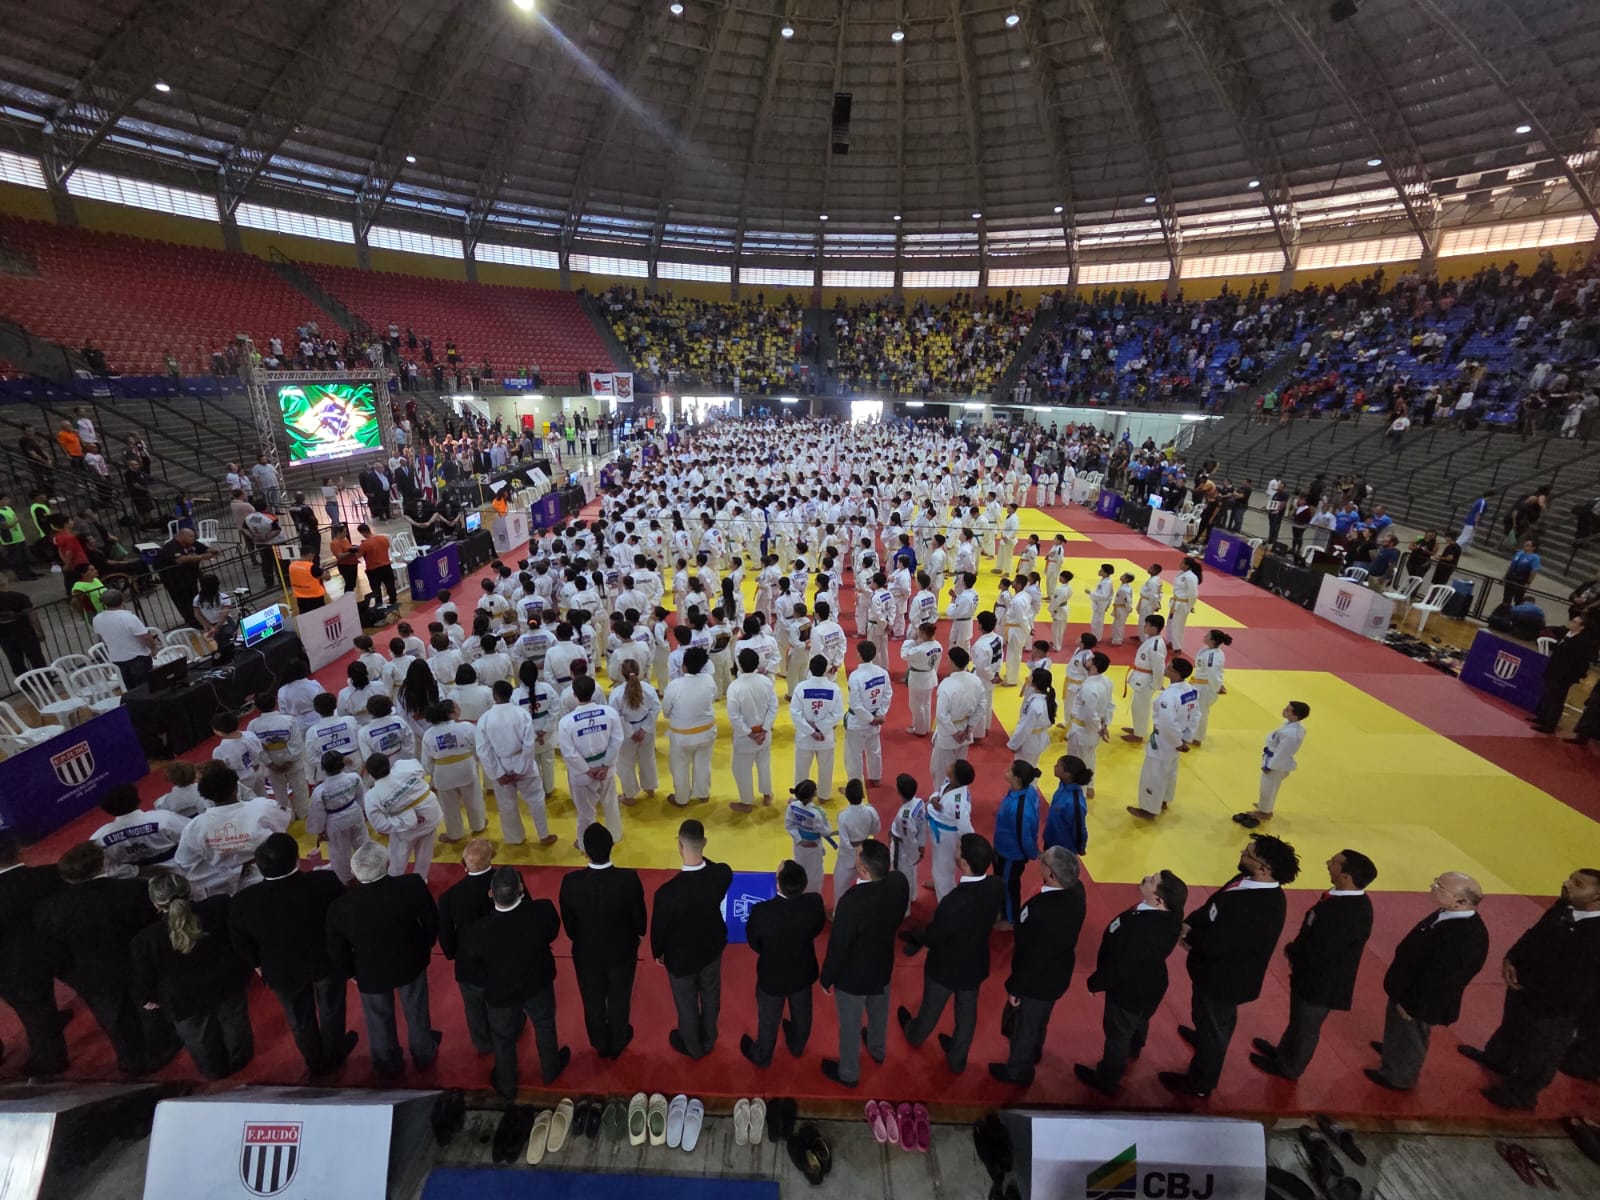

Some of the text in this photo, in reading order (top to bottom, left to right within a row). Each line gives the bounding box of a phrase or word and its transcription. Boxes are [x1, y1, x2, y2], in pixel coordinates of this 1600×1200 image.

[286, 546, 294, 558] 1
[870, 688, 881, 699] SP
[811, 700, 824, 710] SP
[1143, 1171, 1214, 1200] CBJ
